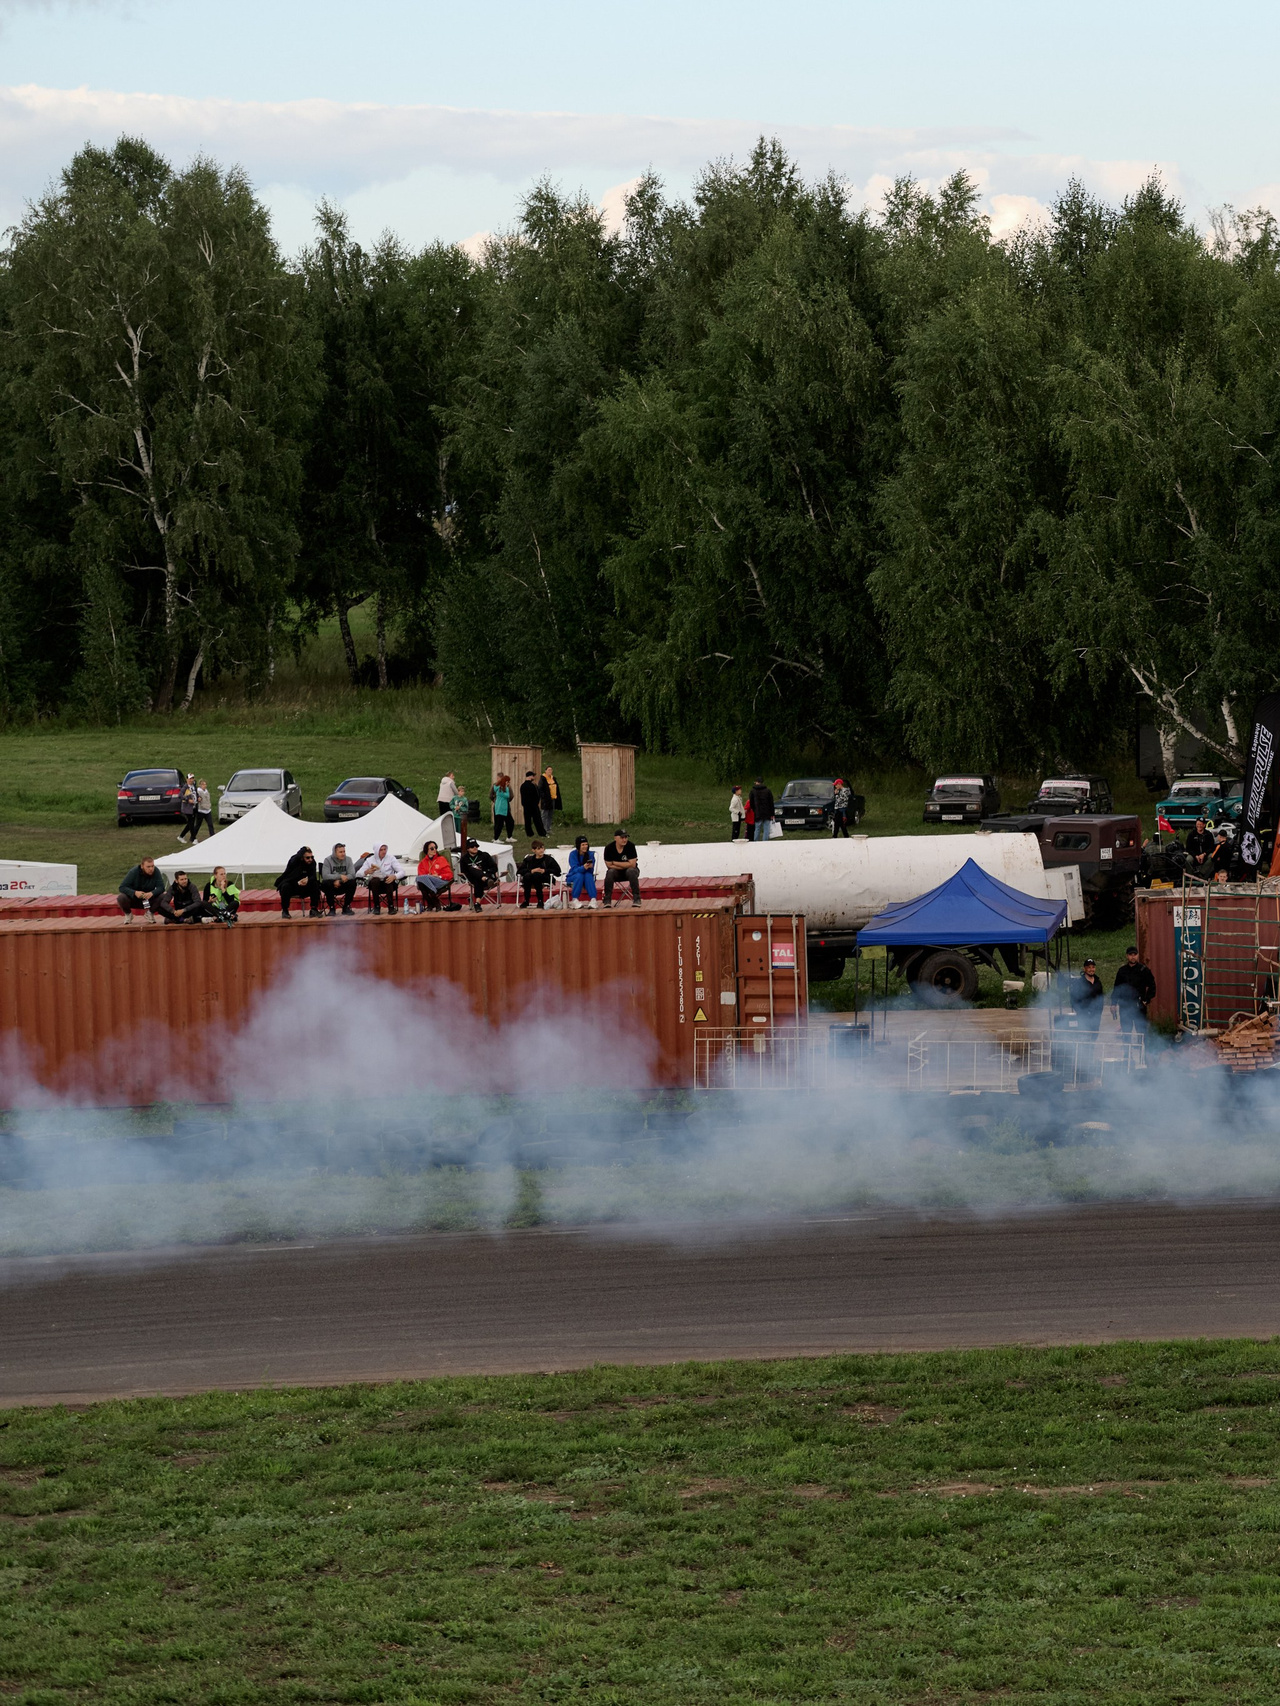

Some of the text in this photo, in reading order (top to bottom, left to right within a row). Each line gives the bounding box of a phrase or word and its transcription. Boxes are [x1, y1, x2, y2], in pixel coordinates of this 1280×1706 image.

[1252, 722, 1260, 751] Барнаул
[1256, 750, 1275, 819] SIBERIAN EXTREME
[772, 948, 794, 957] TAL
